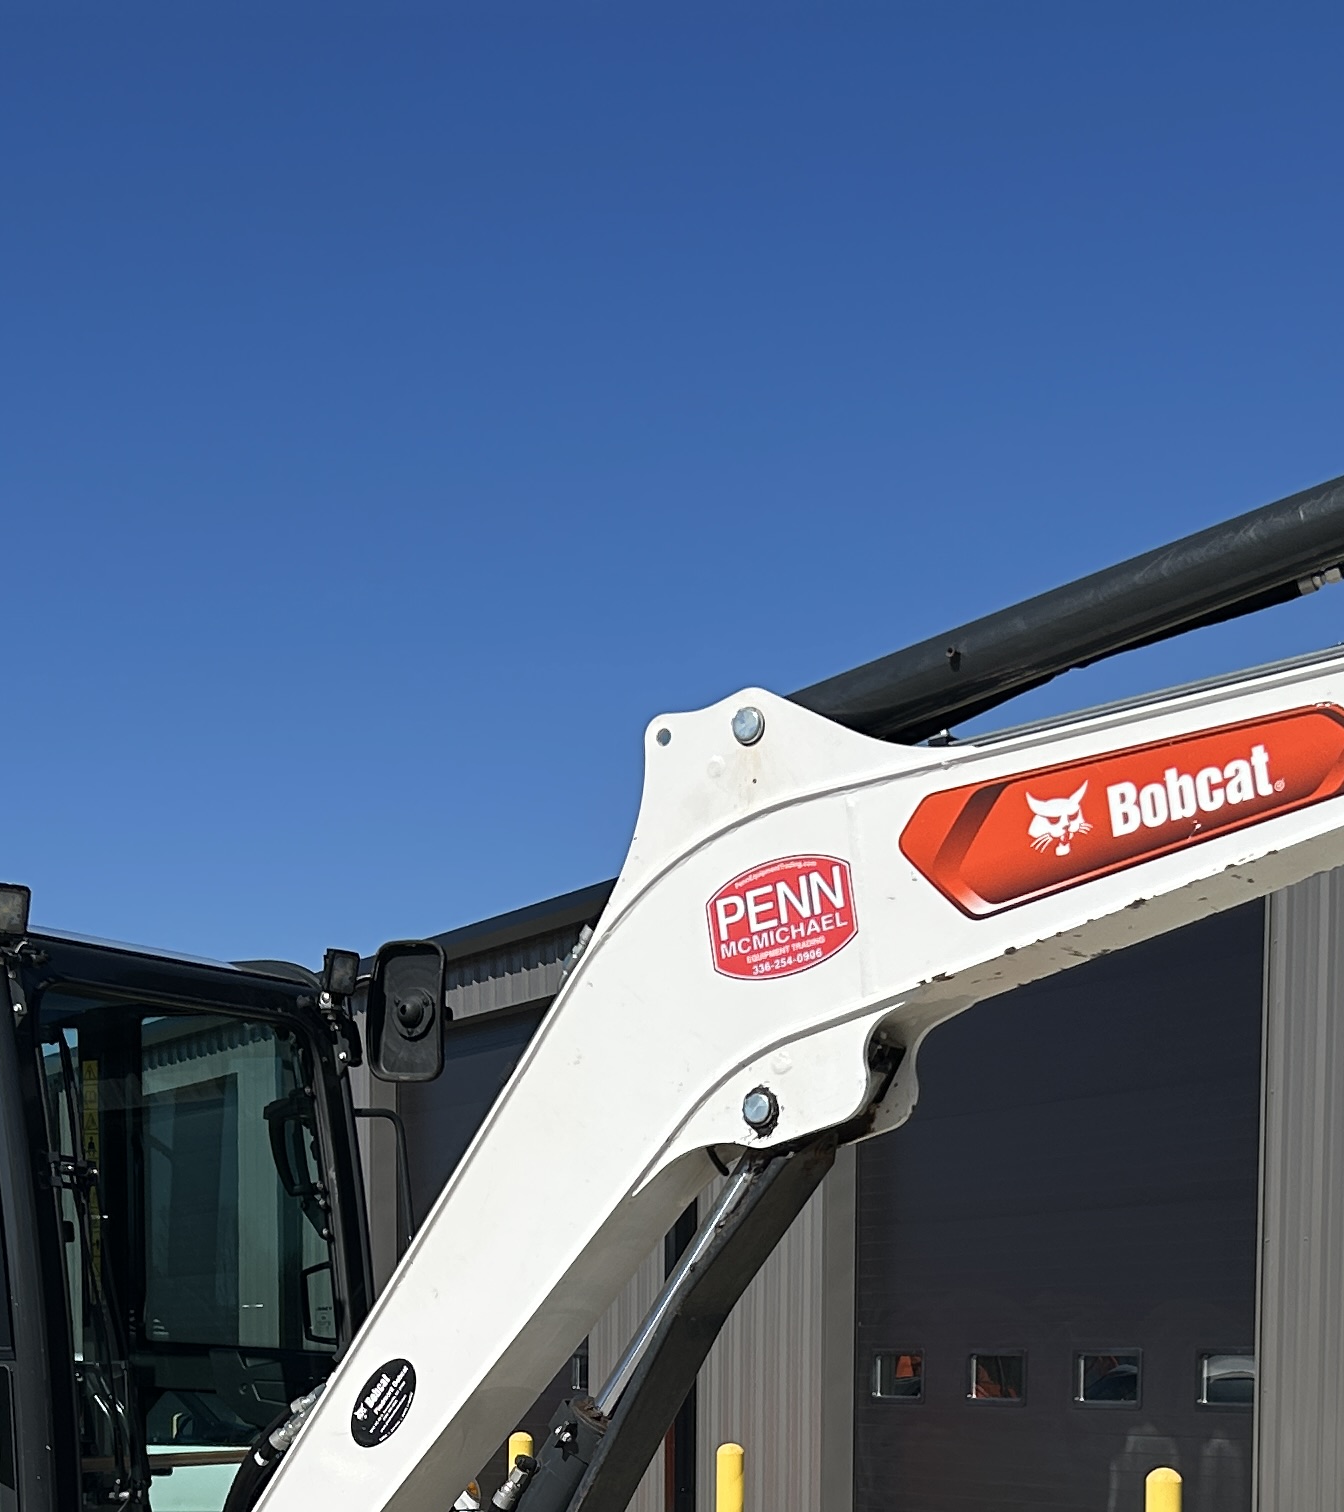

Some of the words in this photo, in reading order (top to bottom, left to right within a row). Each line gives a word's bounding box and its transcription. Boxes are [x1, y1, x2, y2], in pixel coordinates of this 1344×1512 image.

[1106, 744, 1274, 838] Bobcat
[715, 865, 845, 941] PENN
[720, 911, 849, 960] MCMICHAEL
[746, 946, 790, 964] EQUIPMENT
[790, 935, 826, 951] TRADING
[364, 1373, 391, 1409] Bobcat
